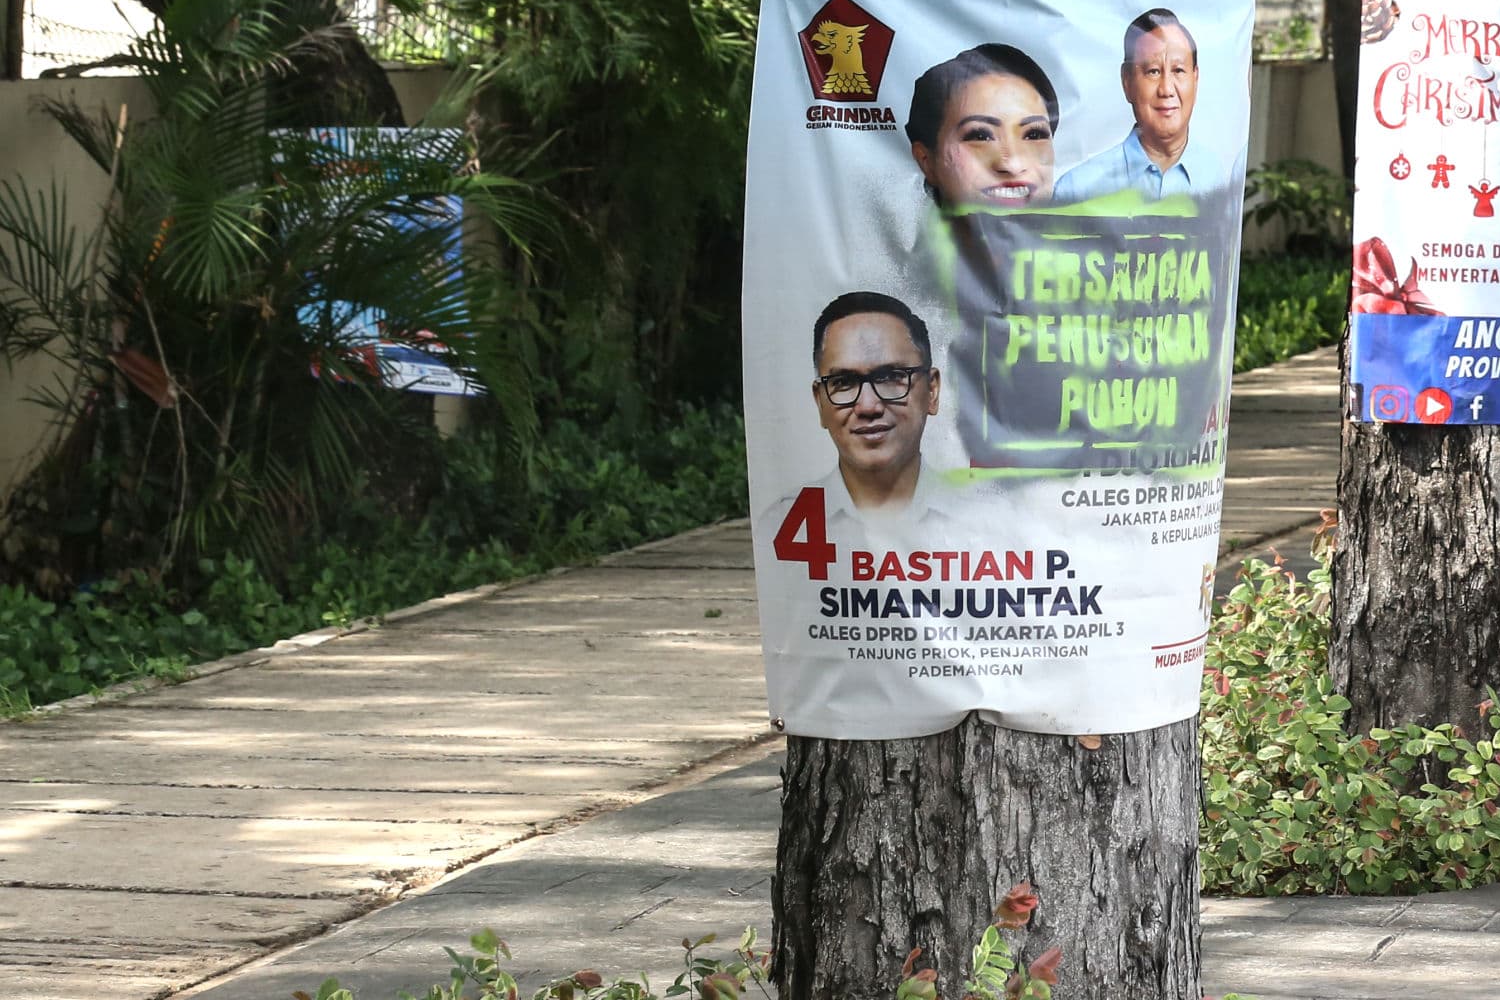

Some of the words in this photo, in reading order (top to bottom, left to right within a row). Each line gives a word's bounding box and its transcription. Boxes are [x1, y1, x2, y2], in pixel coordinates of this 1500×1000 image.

[1422, 243, 1485, 258] SEMOGA
[1011, 249, 1212, 304] TERSANGKA
[1005, 311, 1210, 367] PENUSUKAN
[1058, 376, 1177, 431] POHON
[1061, 488, 1130, 507] CALEG
[1135, 487, 1168, 506] DPR
[1172, 484, 1184, 502] RI
[1187, 480, 1214, 500] DAPIL
[1101, 510, 1167, 527] JAKARTA
[1170, 505, 1203, 522] BARAT,
[773, 487, 837, 581] 4
[1151, 531, 1159, 545] &
[1162, 525, 1213, 545] KEPULAUAN
[852, 550, 1033, 582] BASTIAN
[1046, 550, 1076, 579] P.
[819, 585, 1103, 618] SIMANJUNTAK
[808, 624, 861, 641] CALEG
[866, 626, 917, 642] DPRD
[924, 626, 957, 641] DKI
[964, 625, 1056, 641] JAKARTA
[1063, 623, 1112, 639] DAPIL
[1116, 621, 1125, 637] 3
[848, 647, 917, 660] TANJUNG
[922, 647, 975, 660] PRIOK,
[981, 645, 1088, 659] PENJARINGAN
[1155, 651, 1182, 669] MUDA
[908, 664, 1023, 678] PADEMANGAN
